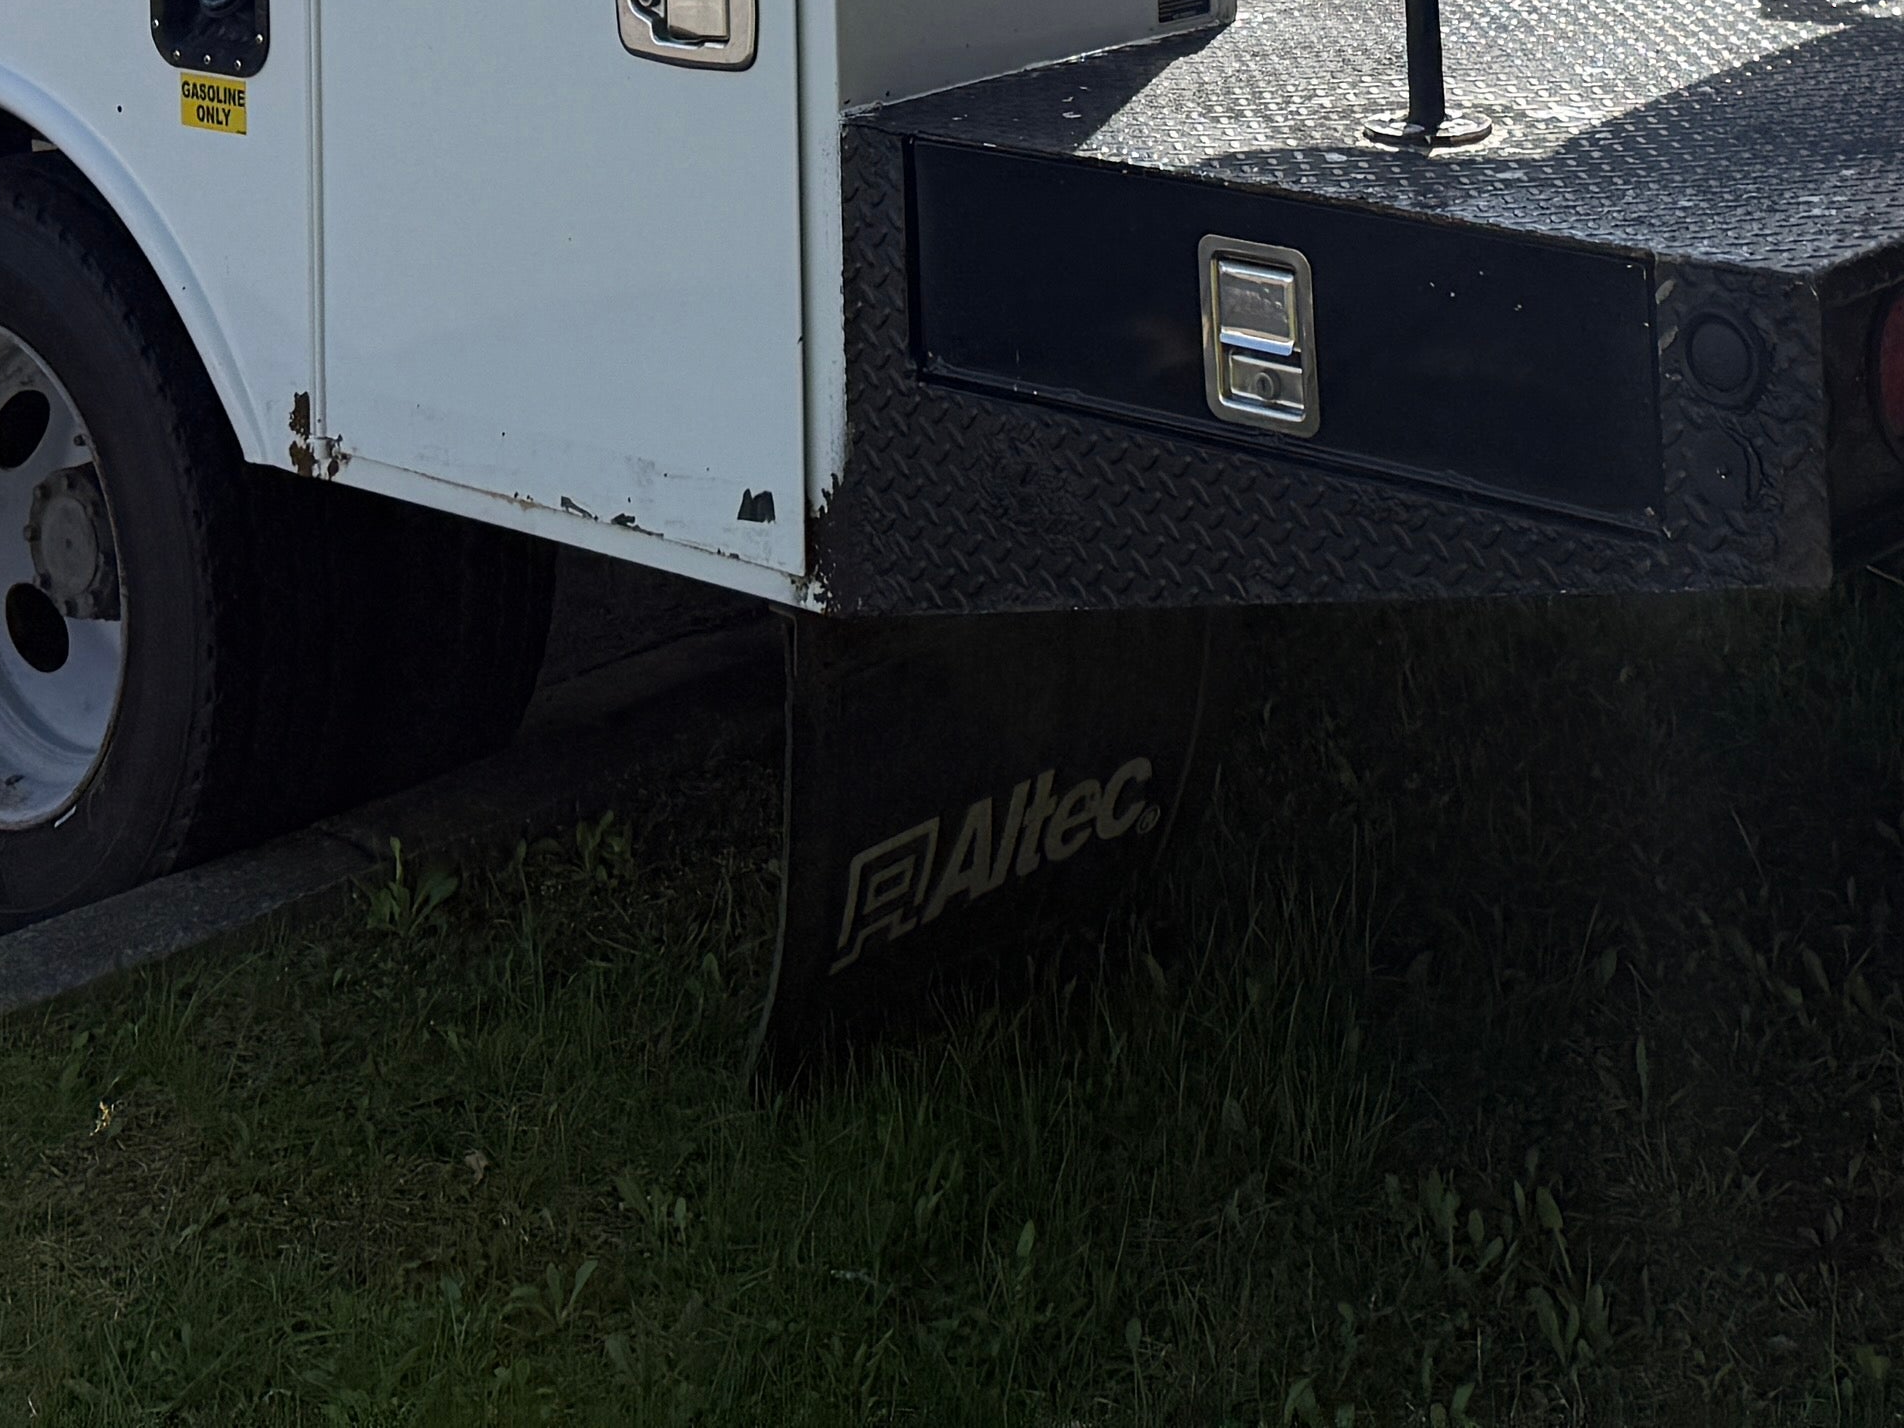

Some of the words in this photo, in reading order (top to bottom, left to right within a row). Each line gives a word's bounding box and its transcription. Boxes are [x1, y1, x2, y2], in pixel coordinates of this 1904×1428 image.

[182, 80, 246, 108] GASOLINE
[197, 104, 232, 127] ONLY
[922, 756, 1153, 925] Altec
